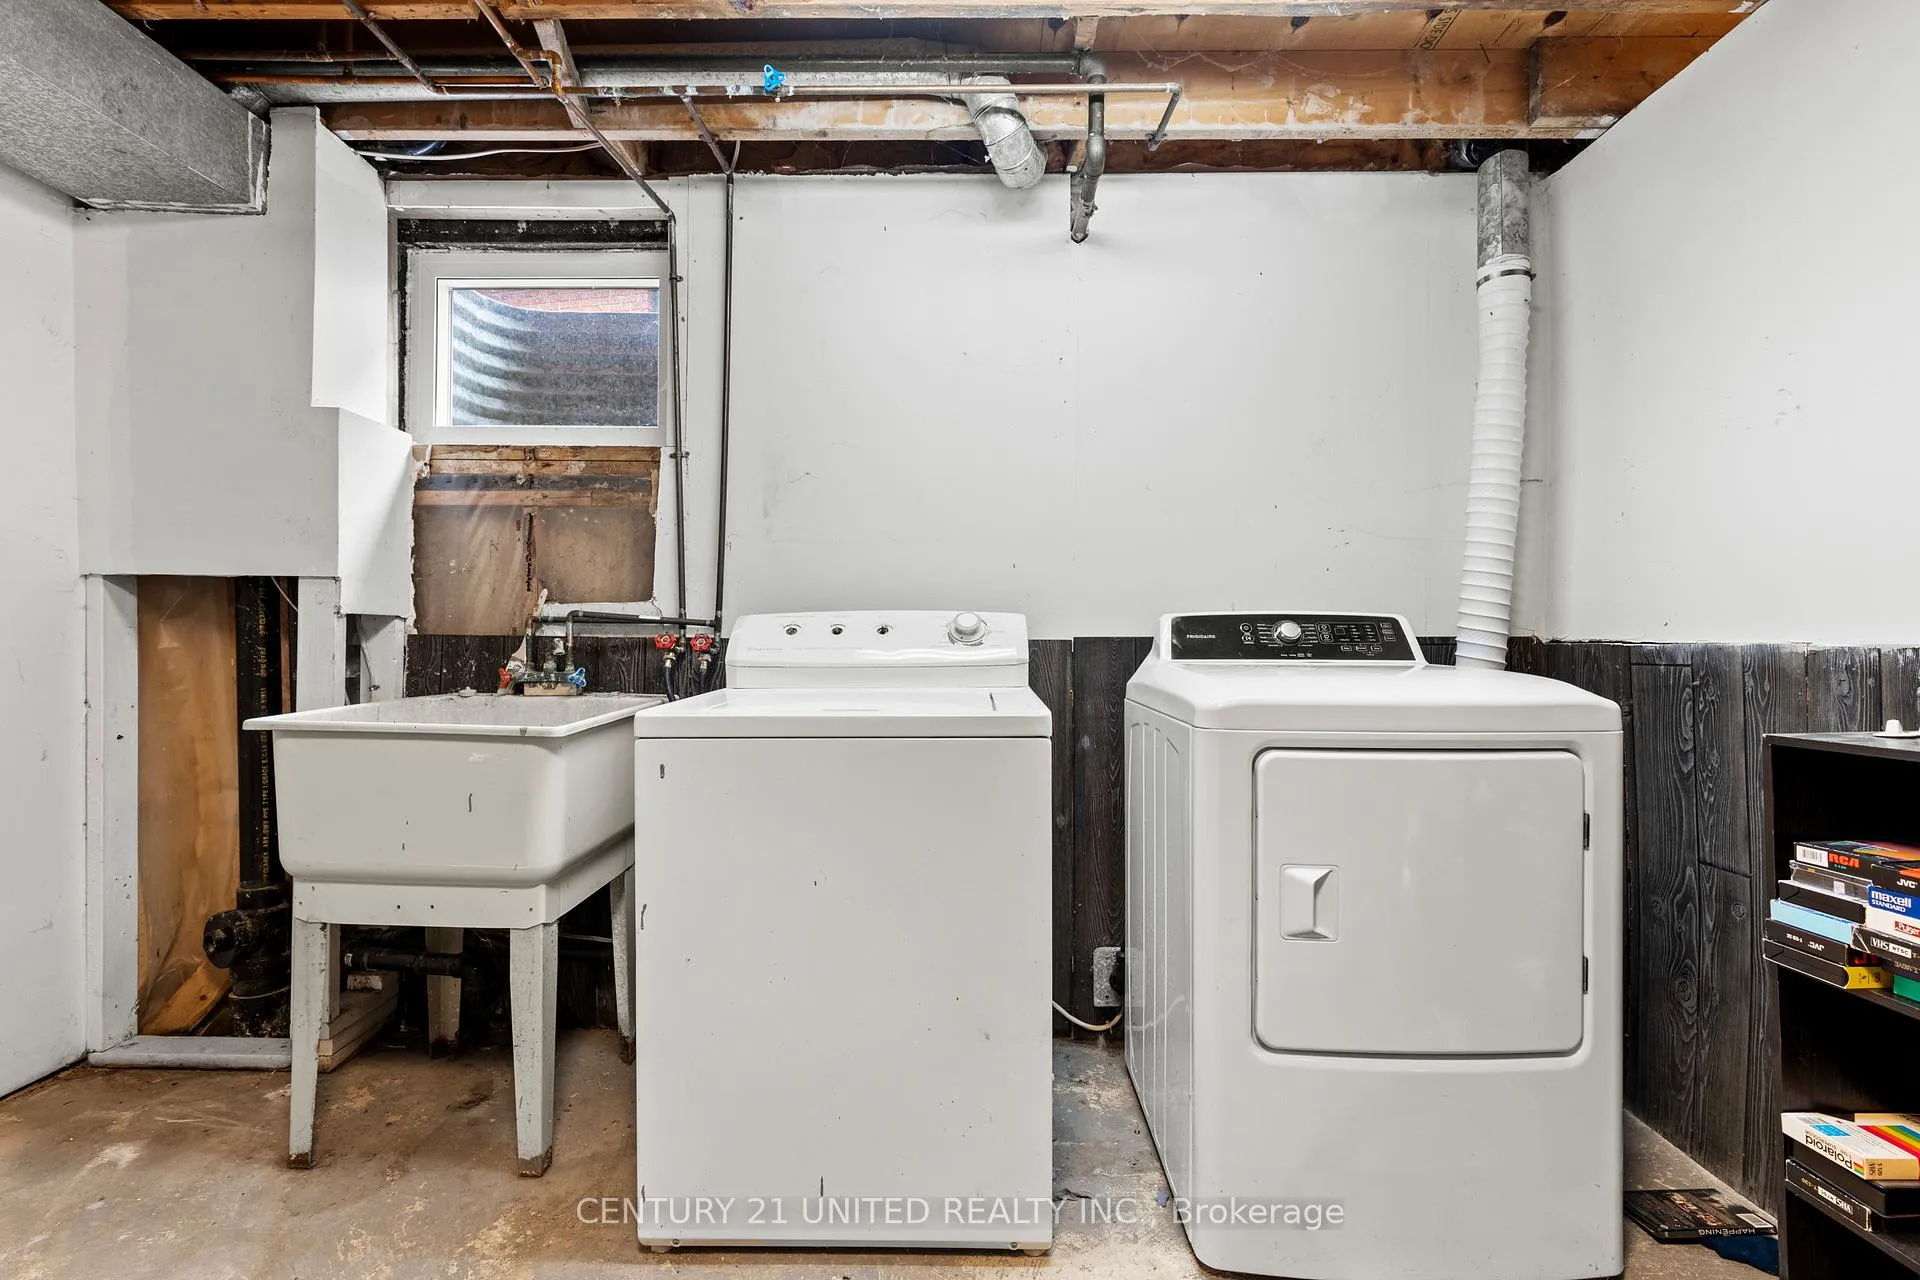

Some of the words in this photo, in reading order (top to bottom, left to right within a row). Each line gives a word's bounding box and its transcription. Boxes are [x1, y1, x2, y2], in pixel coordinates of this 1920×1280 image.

[1430, 16, 1453, 35] SIDE
[1828, 852, 1860, 868] RCA
[1896, 878, 1916, 889] JVC
[1871, 890, 1912, 908] maxell
[1871, 899, 1906, 913] STANDARD
[1808, 941, 1826, 951] JVC
[1872, 938, 1889, 951] VHS
[1804, 1134, 1853, 1170] Polaroid
[1837, 1199, 1852, 1214] VHS
